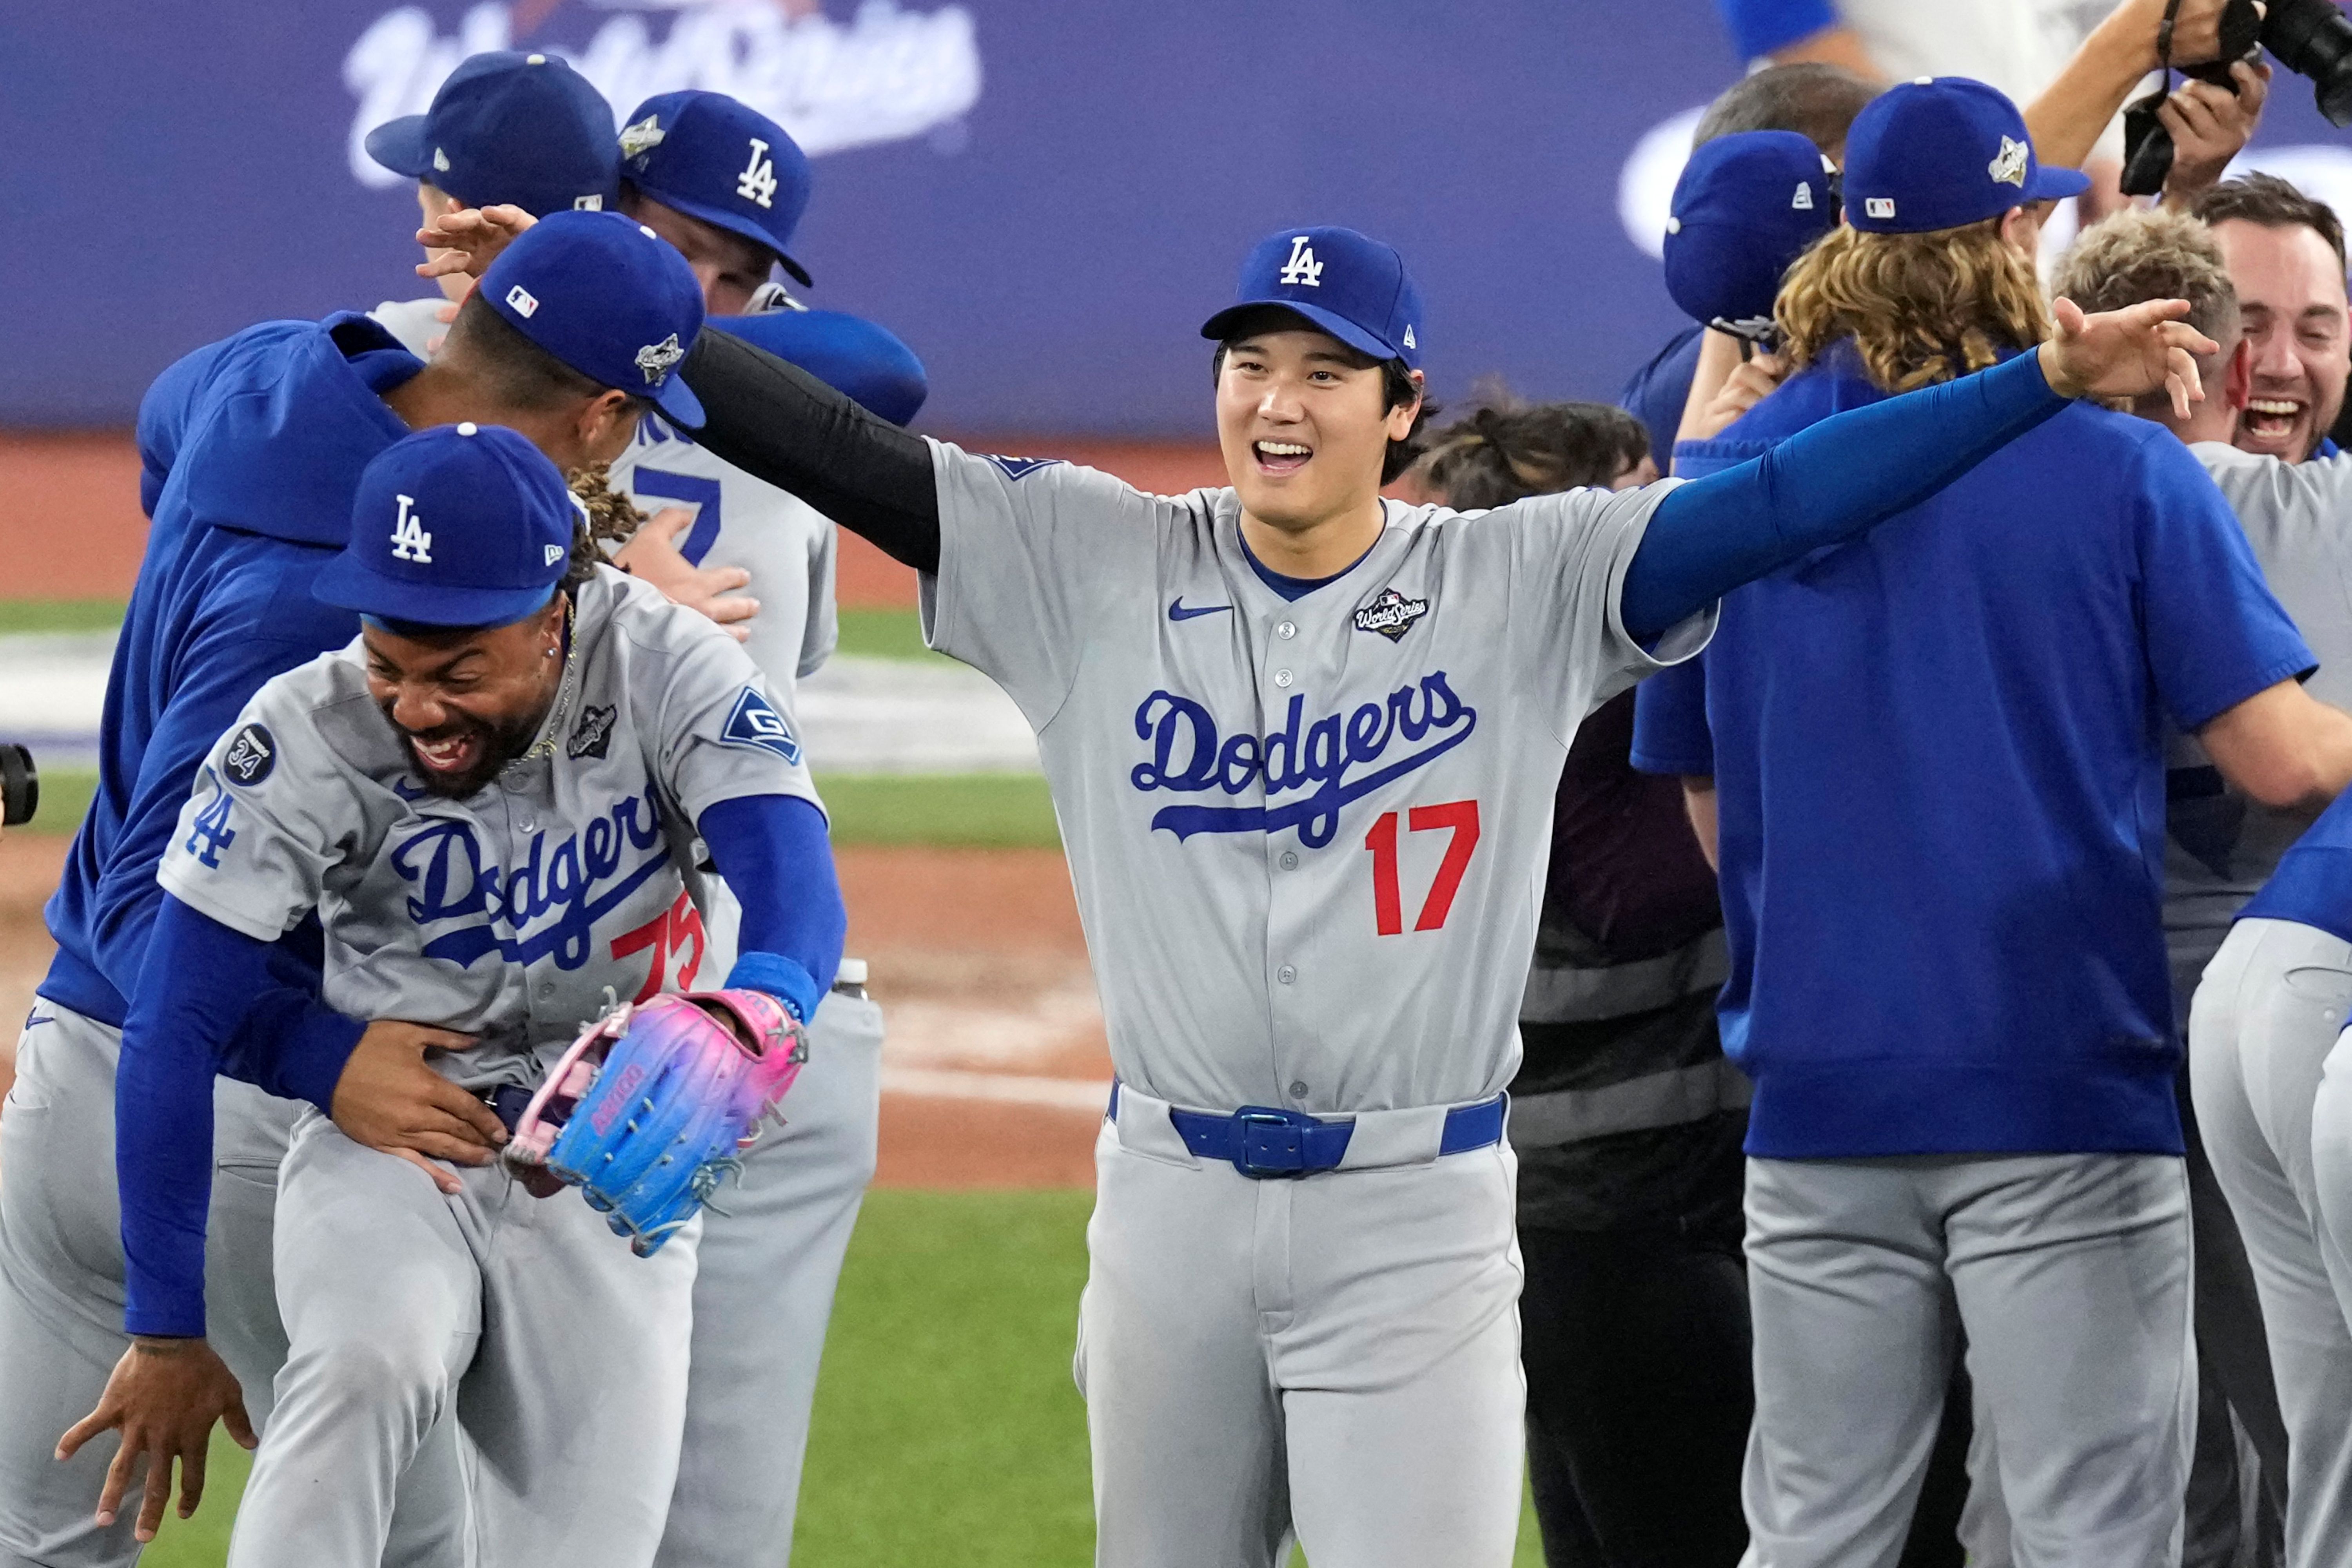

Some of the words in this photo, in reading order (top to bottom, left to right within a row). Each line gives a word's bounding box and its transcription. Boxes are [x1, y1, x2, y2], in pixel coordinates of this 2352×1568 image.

[737, 138, 778, 209] LA
[1280, 236, 1323, 286] LA
[390, 494, 432, 563] LA
[1356, 607, 1397, 629] World
[1392, 602, 1425, 625] Series
[228, 739, 262, 779] 34
[1131, 670, 1477, 849] Dodgers
[1365, 799, 1480, 936] 17
[610, 888, 704, 1006] 75
